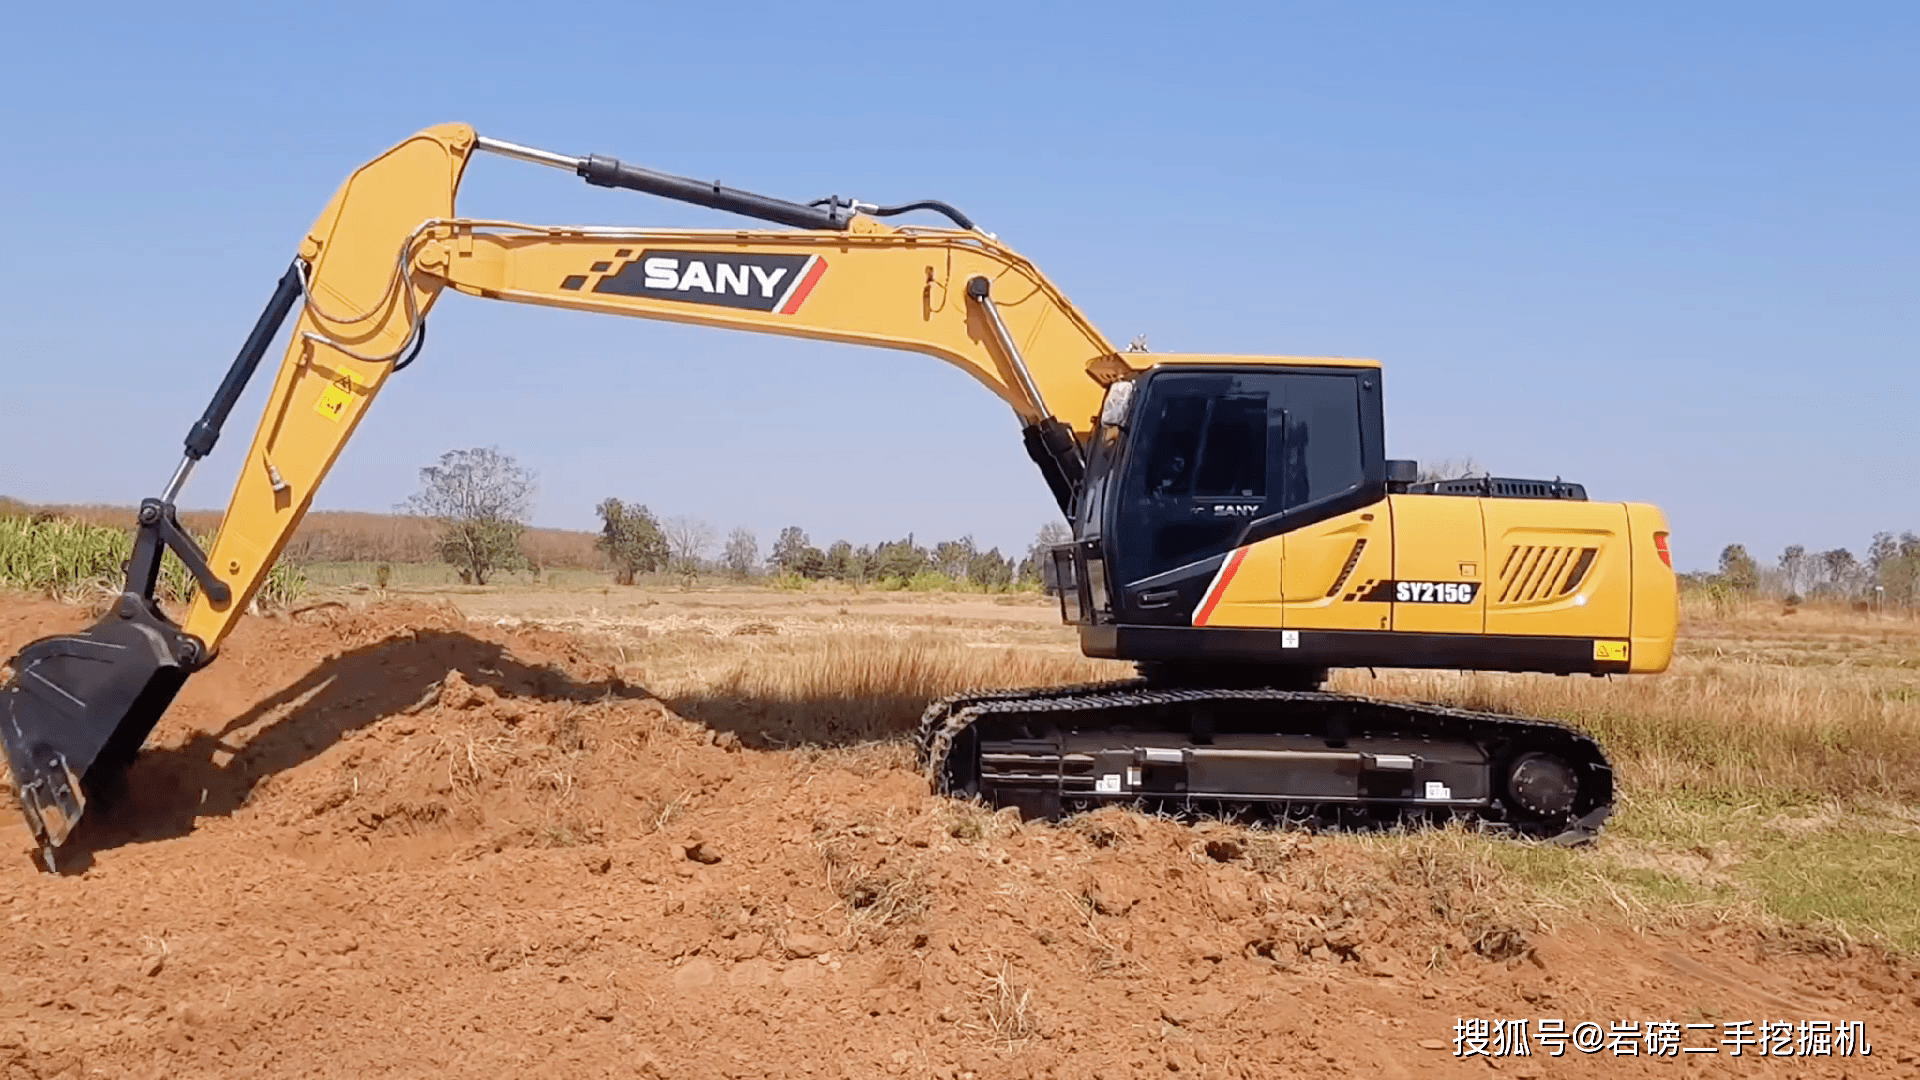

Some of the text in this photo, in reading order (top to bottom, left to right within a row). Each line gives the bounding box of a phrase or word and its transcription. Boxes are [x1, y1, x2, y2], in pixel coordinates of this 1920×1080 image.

[644, 257, 788, 298] SANY
[1213, 504, 1260, 517] SANY
[1396, 581, 1472, 603] SY215C
